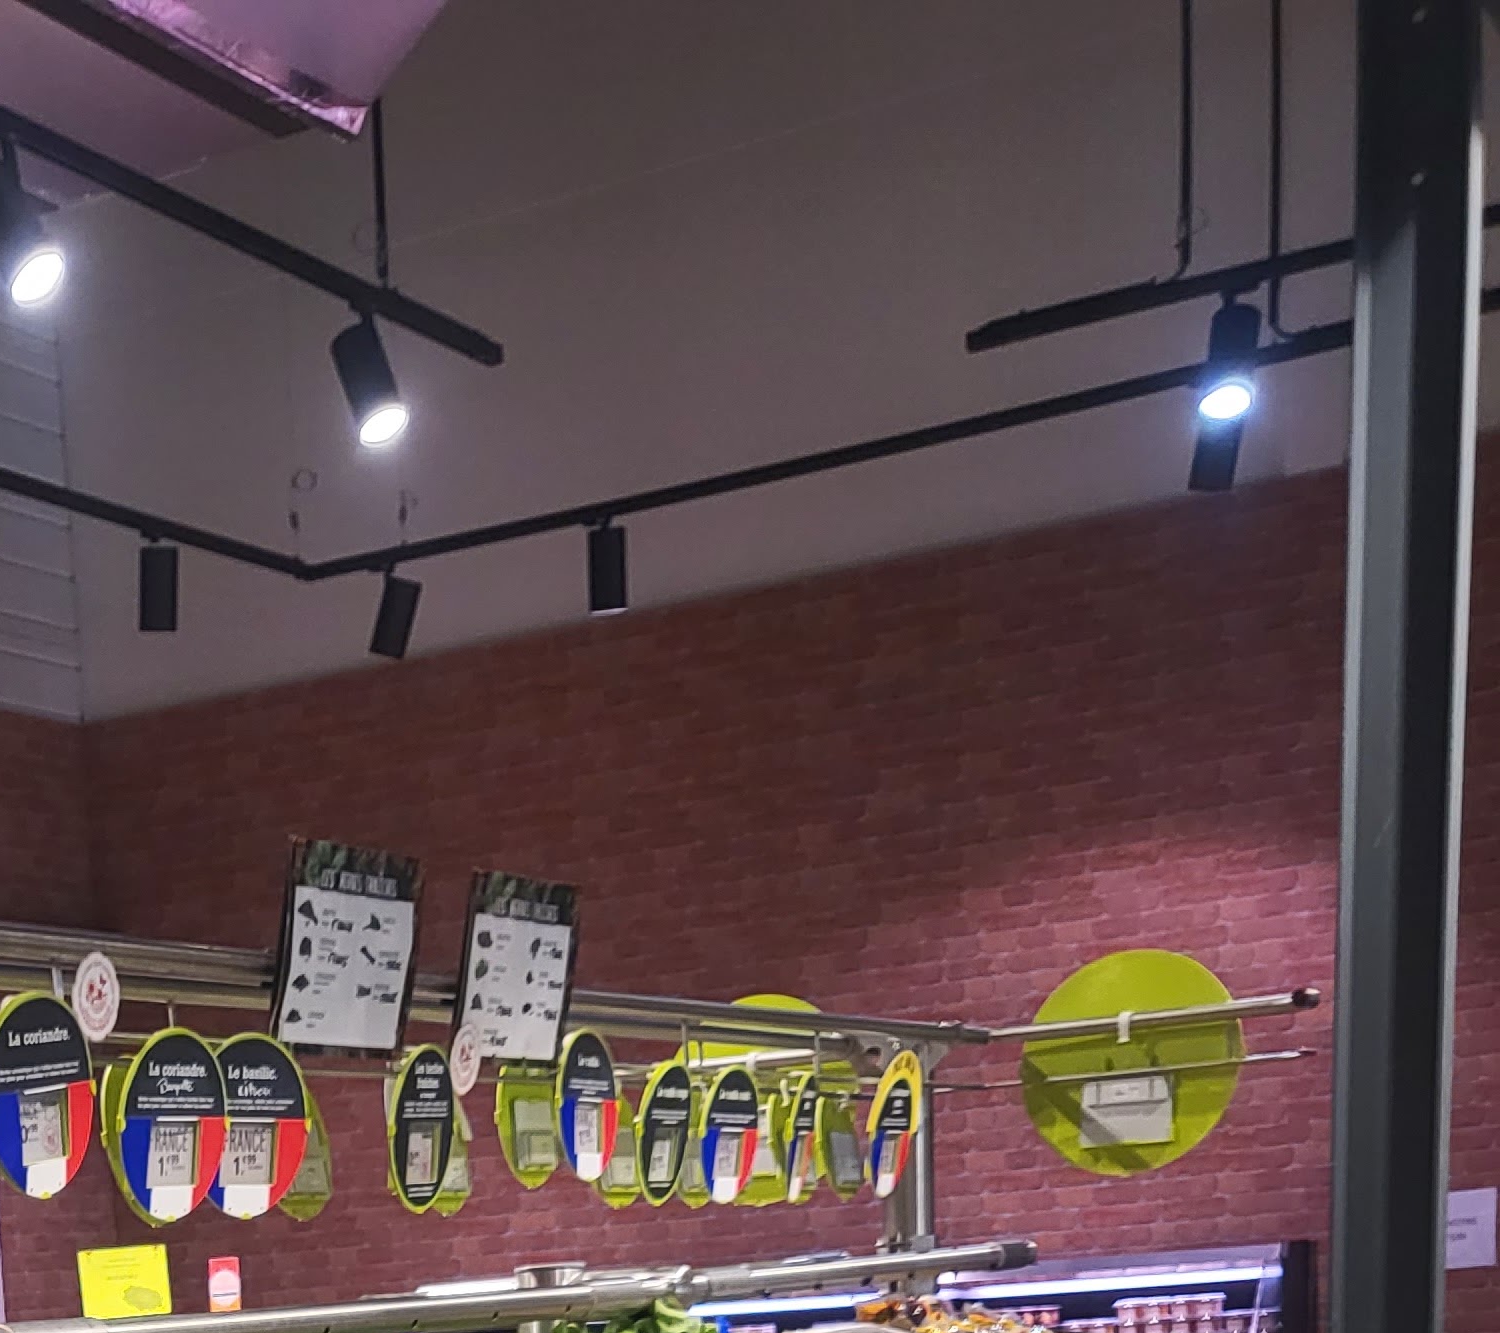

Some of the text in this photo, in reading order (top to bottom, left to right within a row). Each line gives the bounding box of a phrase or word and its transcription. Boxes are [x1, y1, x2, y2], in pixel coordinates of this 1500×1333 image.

[7, 1031, 20, 1046] La
[148, 1061, 160, 1077] La
[228, 1064, 240, 1080] Le
